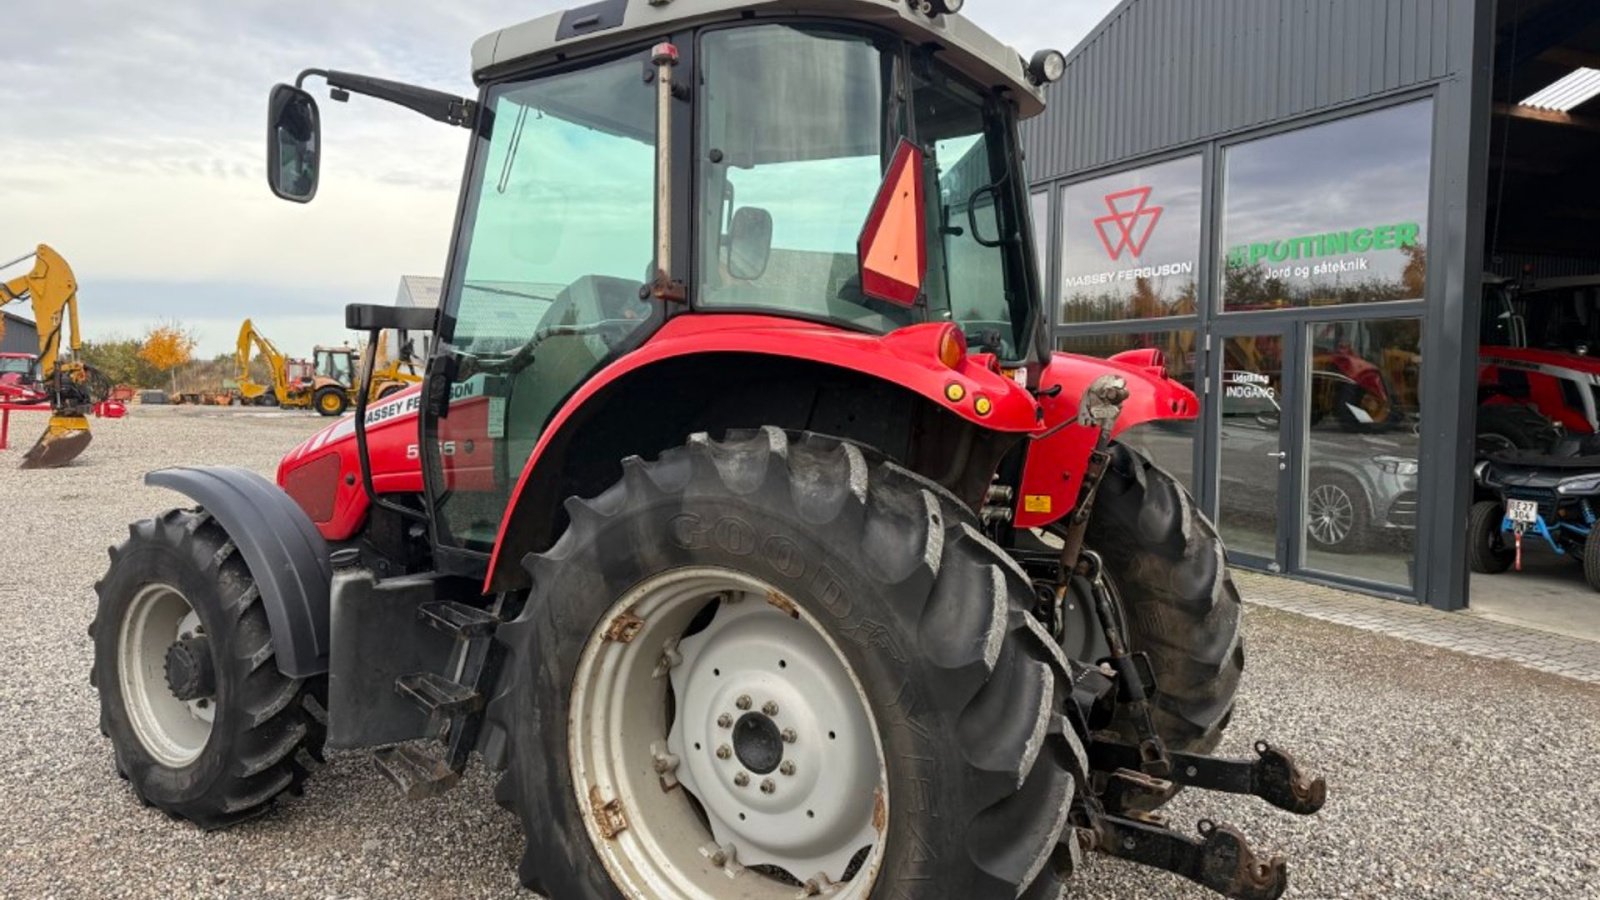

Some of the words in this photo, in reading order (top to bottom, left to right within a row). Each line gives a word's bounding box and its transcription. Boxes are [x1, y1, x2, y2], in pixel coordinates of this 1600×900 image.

[1065, 270, 1115, 288] MASSEY
[1119, 260, 1193, 280] FERGUSON
[1265, 265, 1291, 279] Jord
[1294, 266, 1309, 279] og
[1313, 256, 1368, 275] såteknik
[1226, 385, 1275, 399] INDGANG
[365, 401, 403, 424] ASSEY
